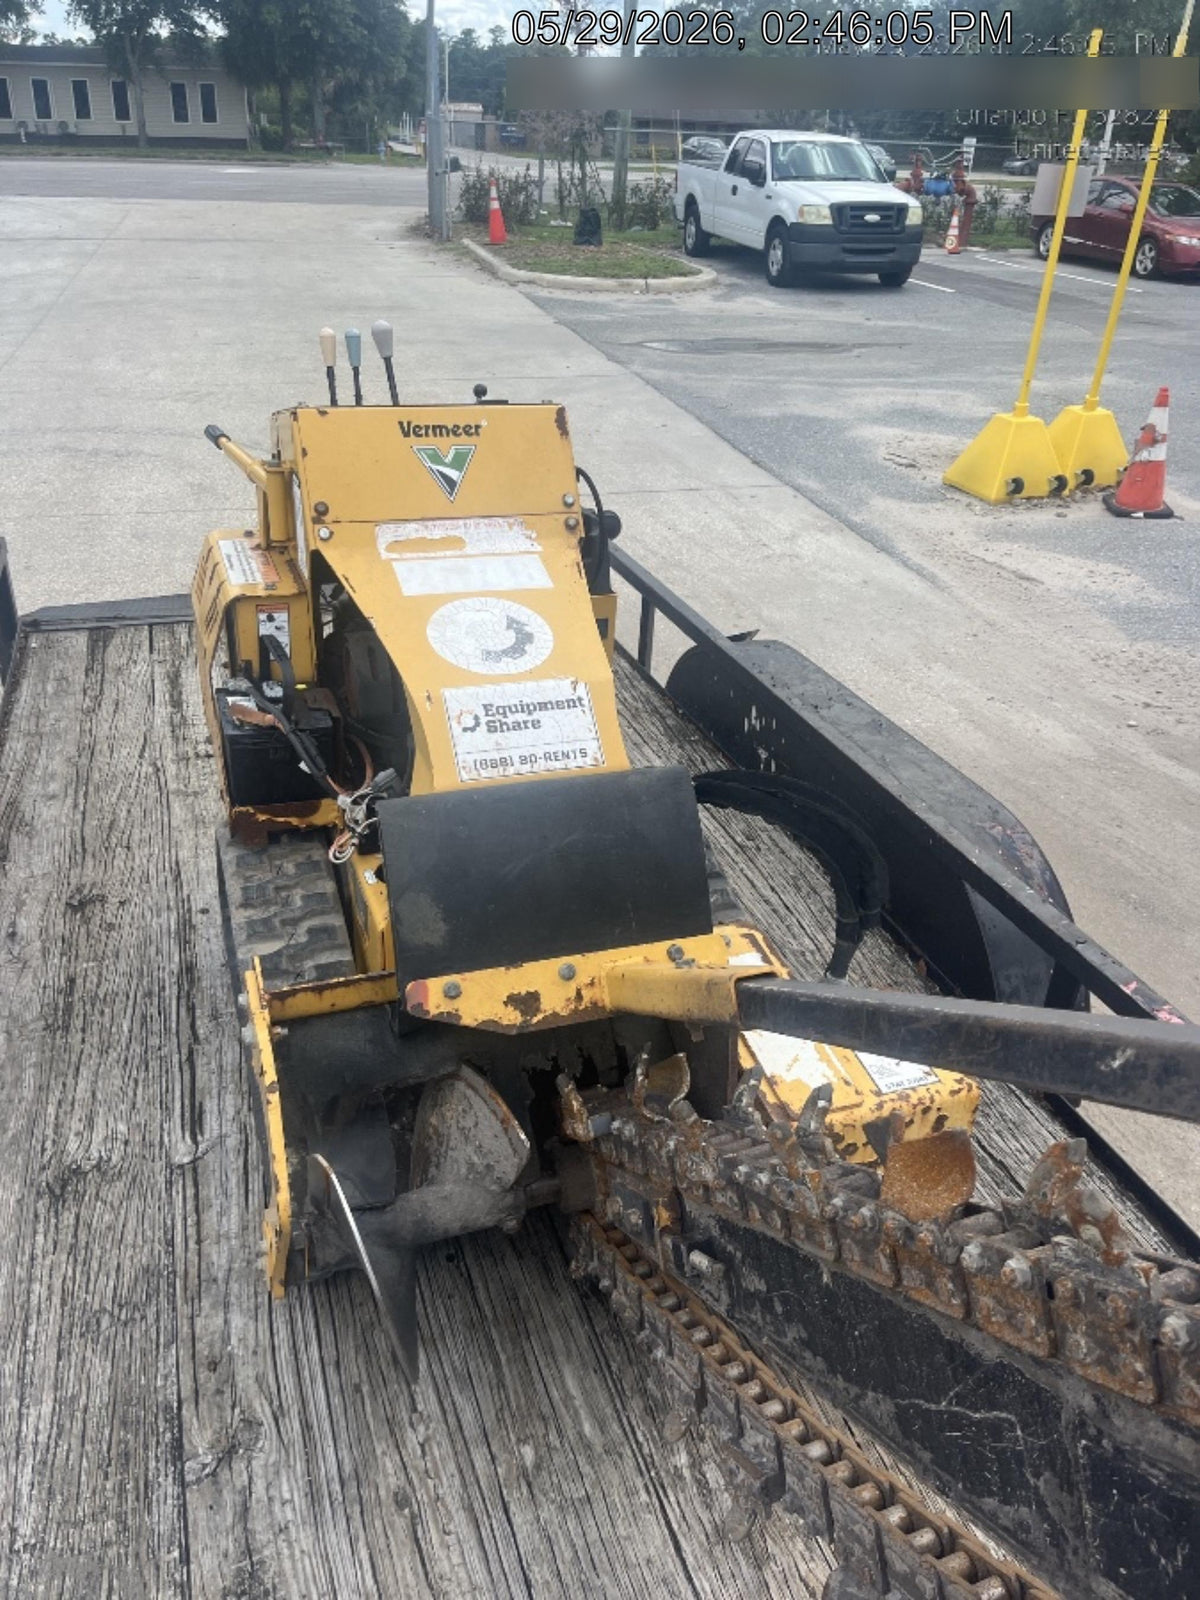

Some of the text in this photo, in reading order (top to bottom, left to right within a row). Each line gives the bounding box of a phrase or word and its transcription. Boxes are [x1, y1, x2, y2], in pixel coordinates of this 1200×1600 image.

[397, 420, 482, 438] Vermeer
[482, 696, 586, 719] Equipment
[485, 718, 542, 734] Share
